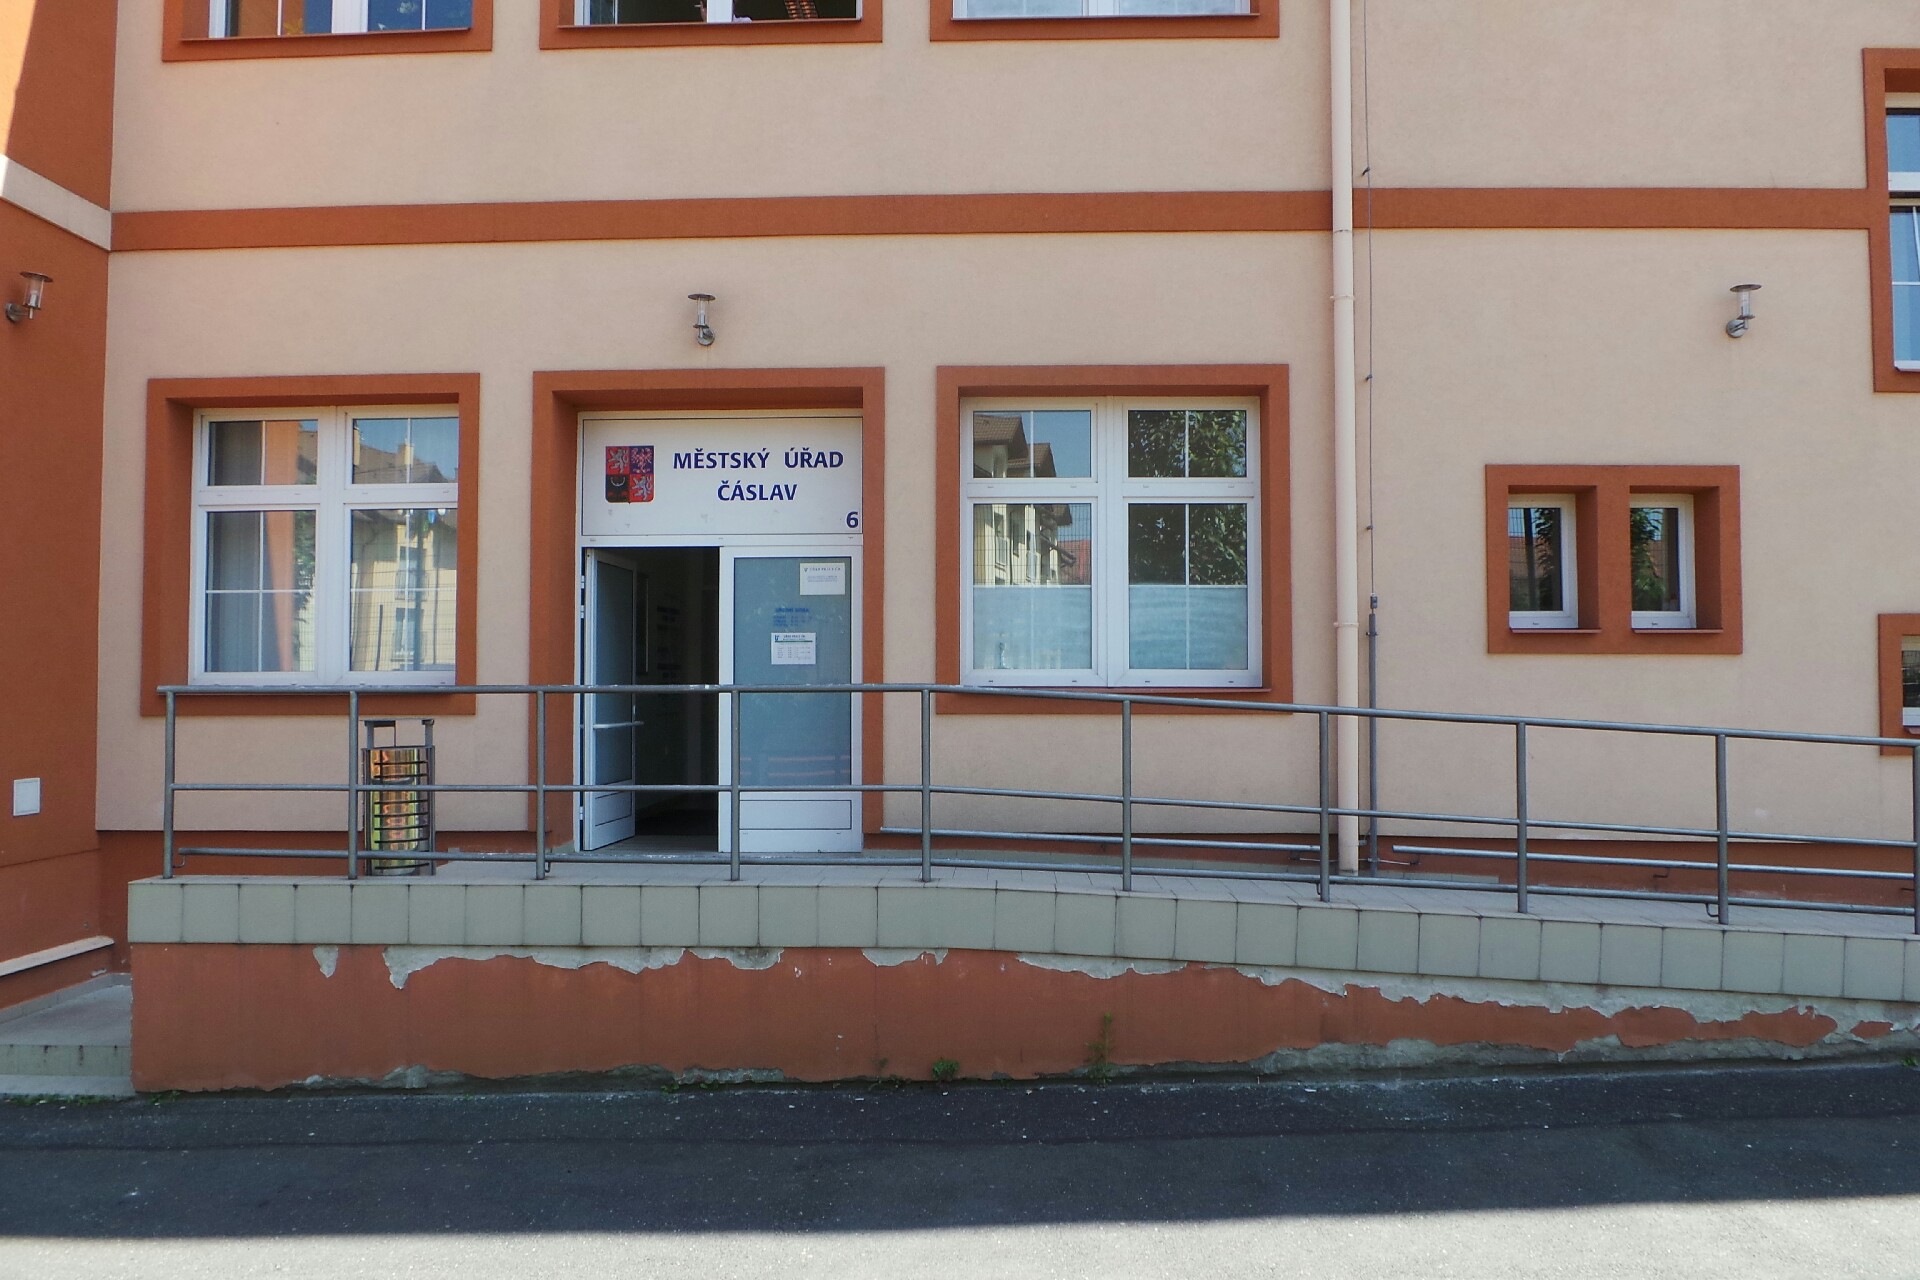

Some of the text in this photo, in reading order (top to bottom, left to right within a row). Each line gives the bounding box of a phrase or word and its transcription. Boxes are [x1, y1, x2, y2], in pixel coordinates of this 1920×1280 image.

[673, 447, 844, 469] MĚSTSKÝ ÚŘAD
[717, 480, 798, 501] ČÁSLAV
[846, 511, 859, 529] 6
